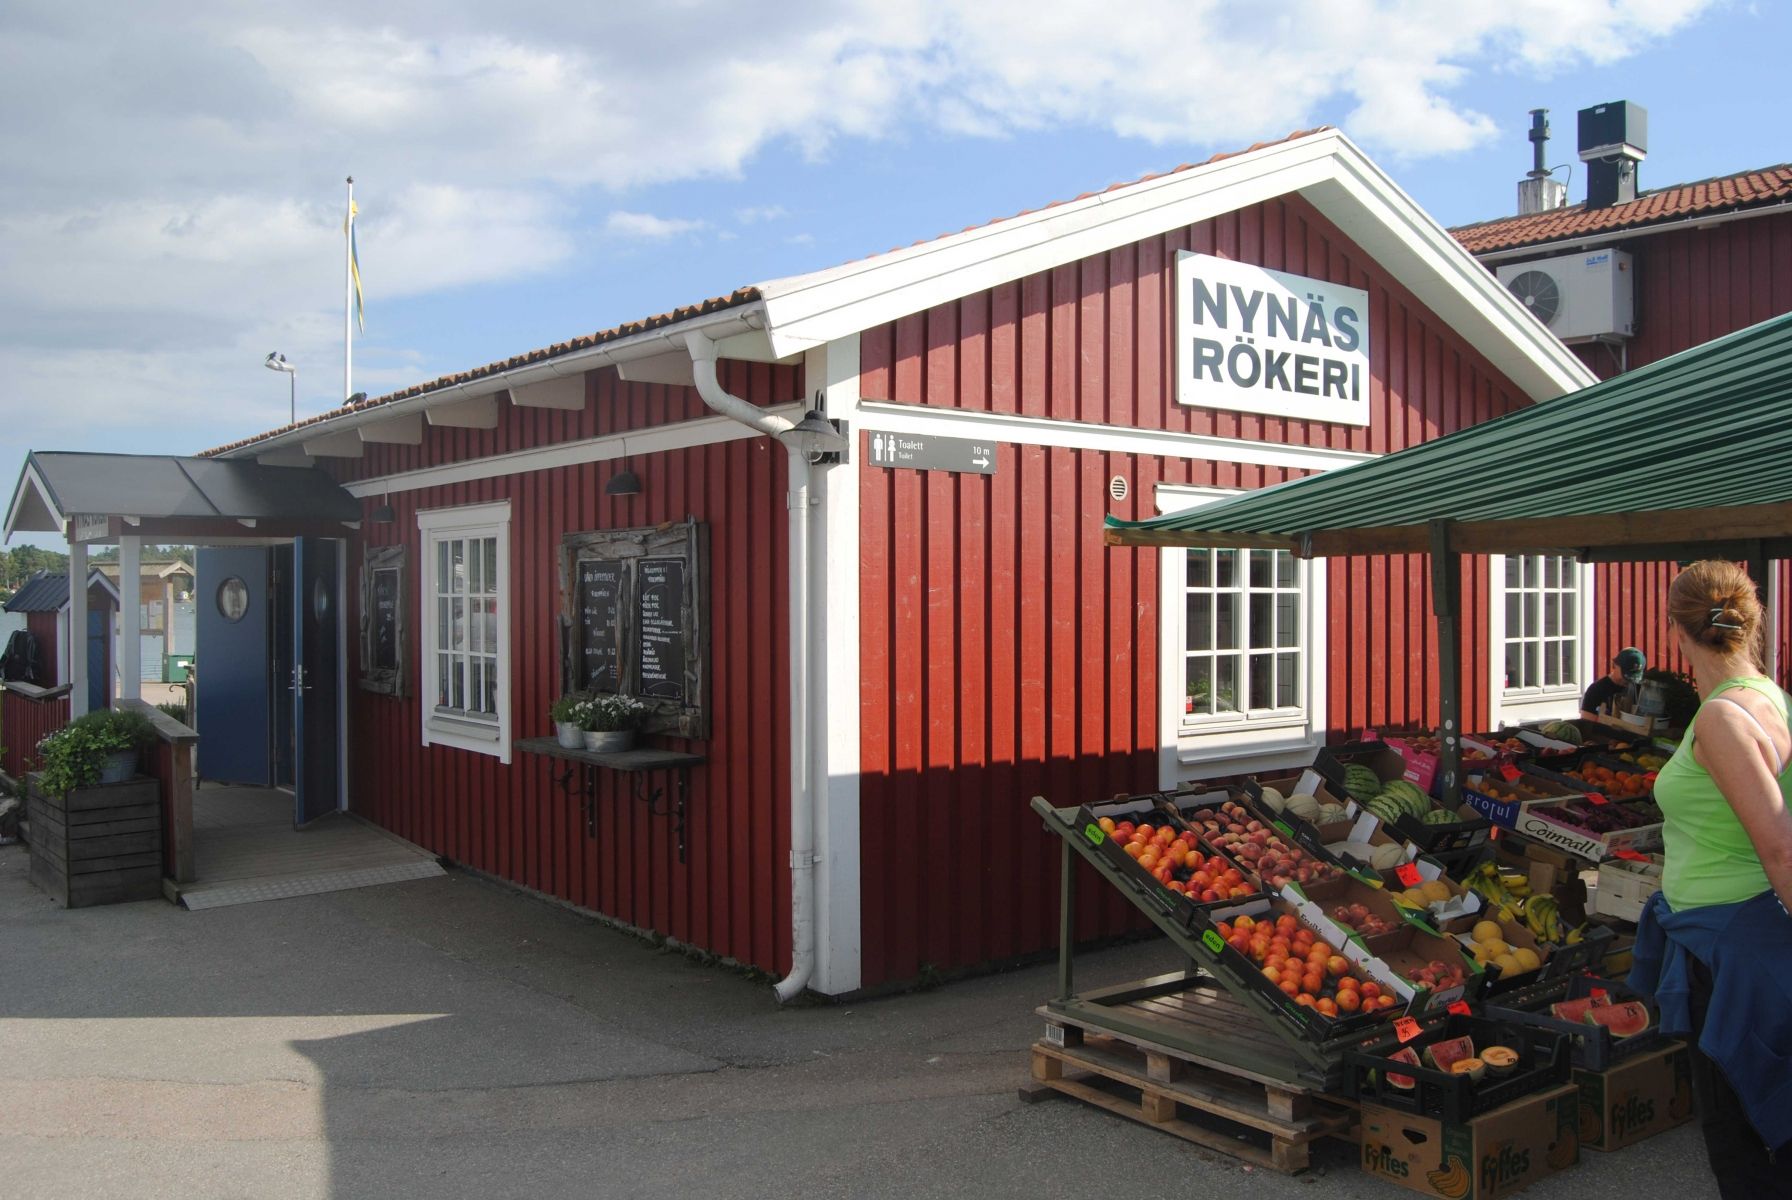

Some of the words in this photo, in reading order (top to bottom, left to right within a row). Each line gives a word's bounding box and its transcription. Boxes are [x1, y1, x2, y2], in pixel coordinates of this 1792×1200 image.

[1193, 277, 1360, 352] NYNÄS
[1193, 335, 1360, 402] RÖKERI
[898, 439, 924, 451] Toalett
[972, 446, 982, 455] 10
[983, 448, 990, 456] m
[1205, 933, 1221, 949] eden
[1365, 1143, 1409, 1178] Fyffes
